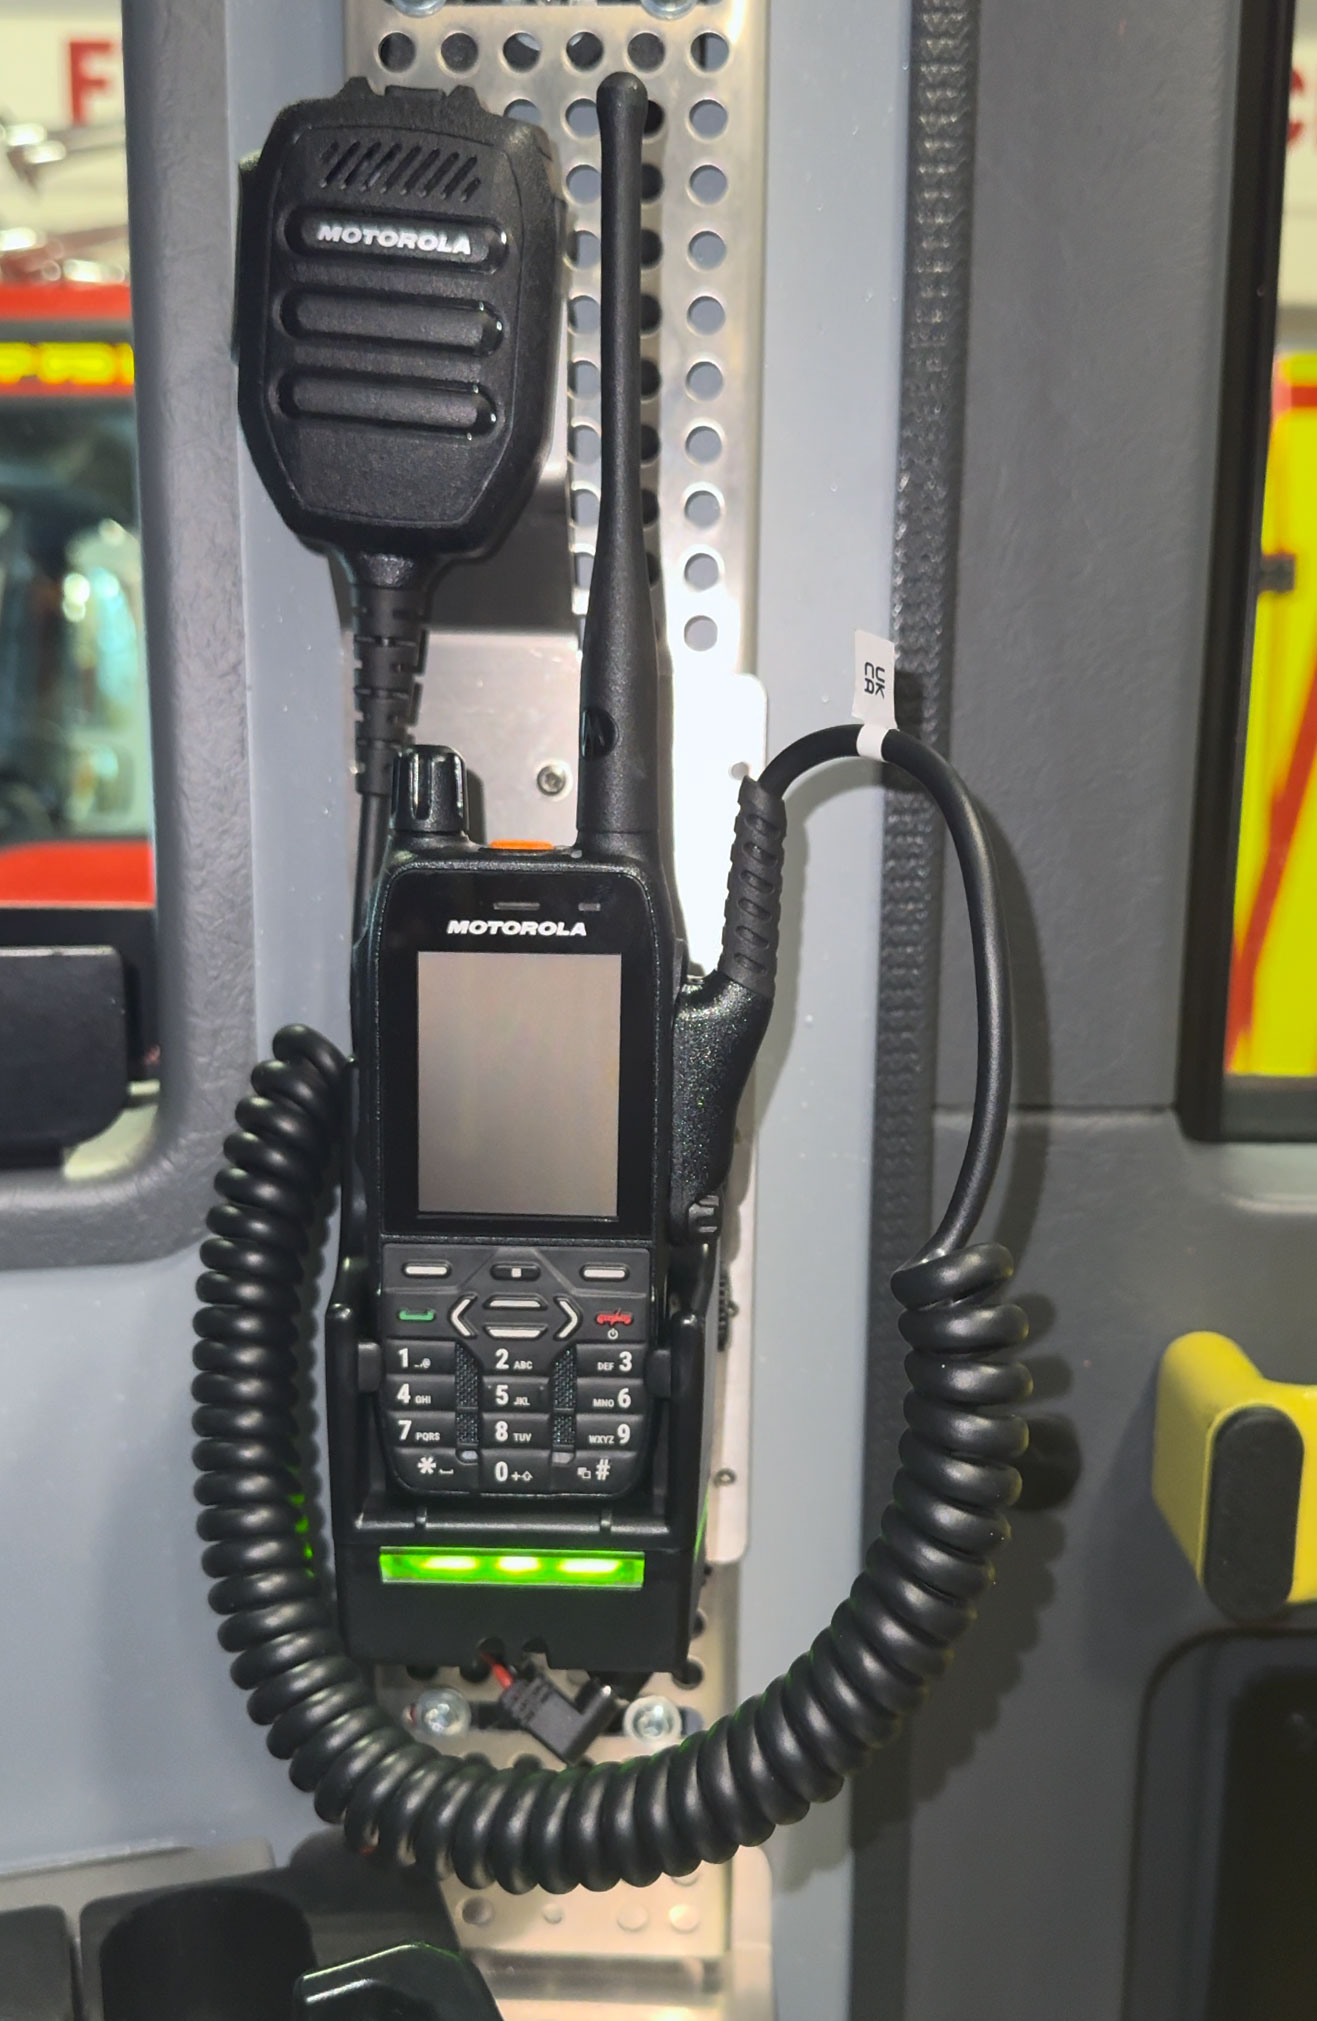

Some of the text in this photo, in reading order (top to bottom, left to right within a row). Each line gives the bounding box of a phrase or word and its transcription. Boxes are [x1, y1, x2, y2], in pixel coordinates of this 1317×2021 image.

[317, 224, 471, 255] MOTOROLA
[447, 920, 587, 936] MOTOROLA
[398, 1347, 409, 1368] 1
[495, 1348, 533, 1370] 2 ABC
[597, 1351, 633, 1372] DEF 3
[396, 1383, 432, 1404] 4 GHI
[495, 1384, 509, 1406] 5
[592, 1387, 632, 1408] MNO 6
[398, 1419, 441, 1442] 7 PQRS
[495, 1420, 533, 1442] 8 TUV
[588, 1423, 631, 1445] WXYZ 9
[495, 1461, 509, 1482] 0
[595, 1458, 611, 1481] #
